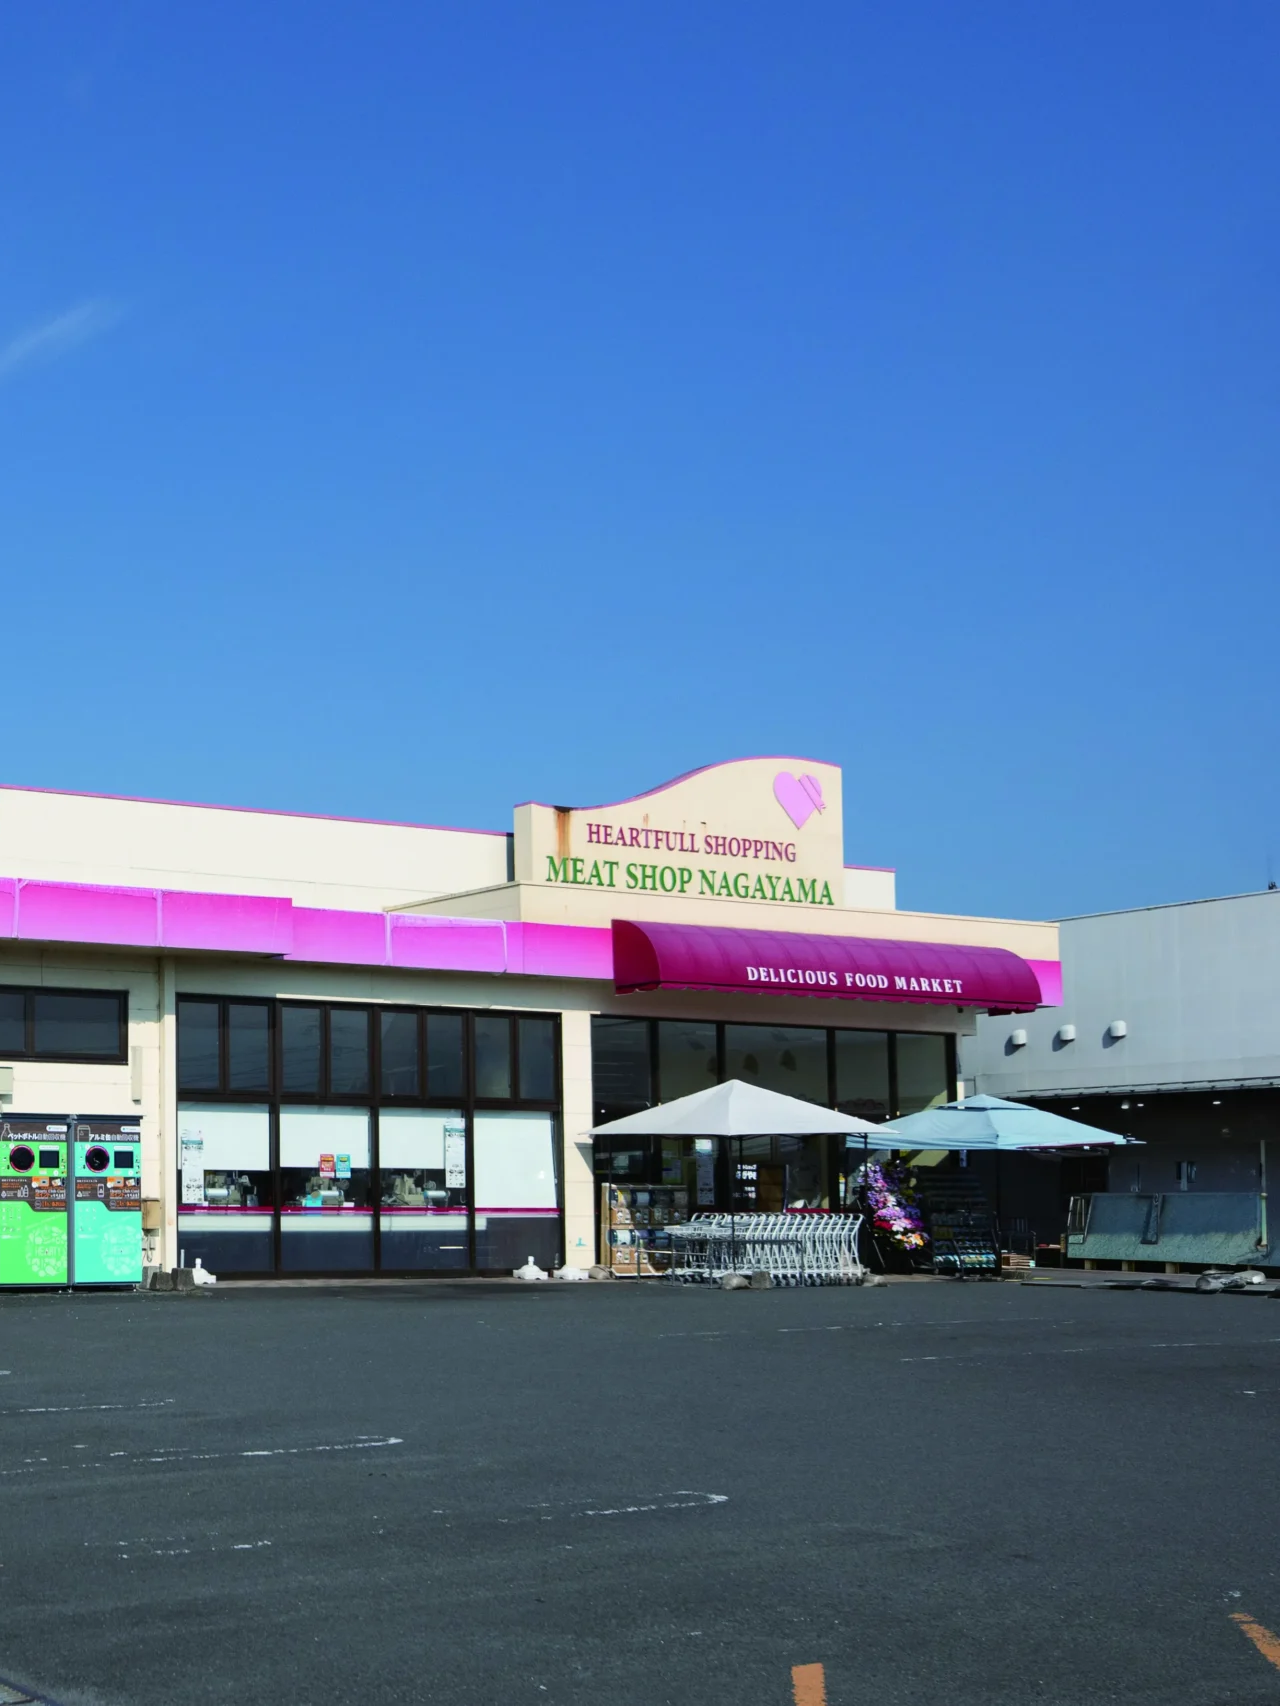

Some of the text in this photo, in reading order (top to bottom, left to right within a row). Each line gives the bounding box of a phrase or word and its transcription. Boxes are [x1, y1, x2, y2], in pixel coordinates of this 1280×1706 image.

[586, 823, 797, 863] HEARTFULL SHOPPING
[546, 855, 835, 906] MEAT SHOP NAGAYAMA
[746, 966, 963, 994] DELICIOUS FOOD MARKET
